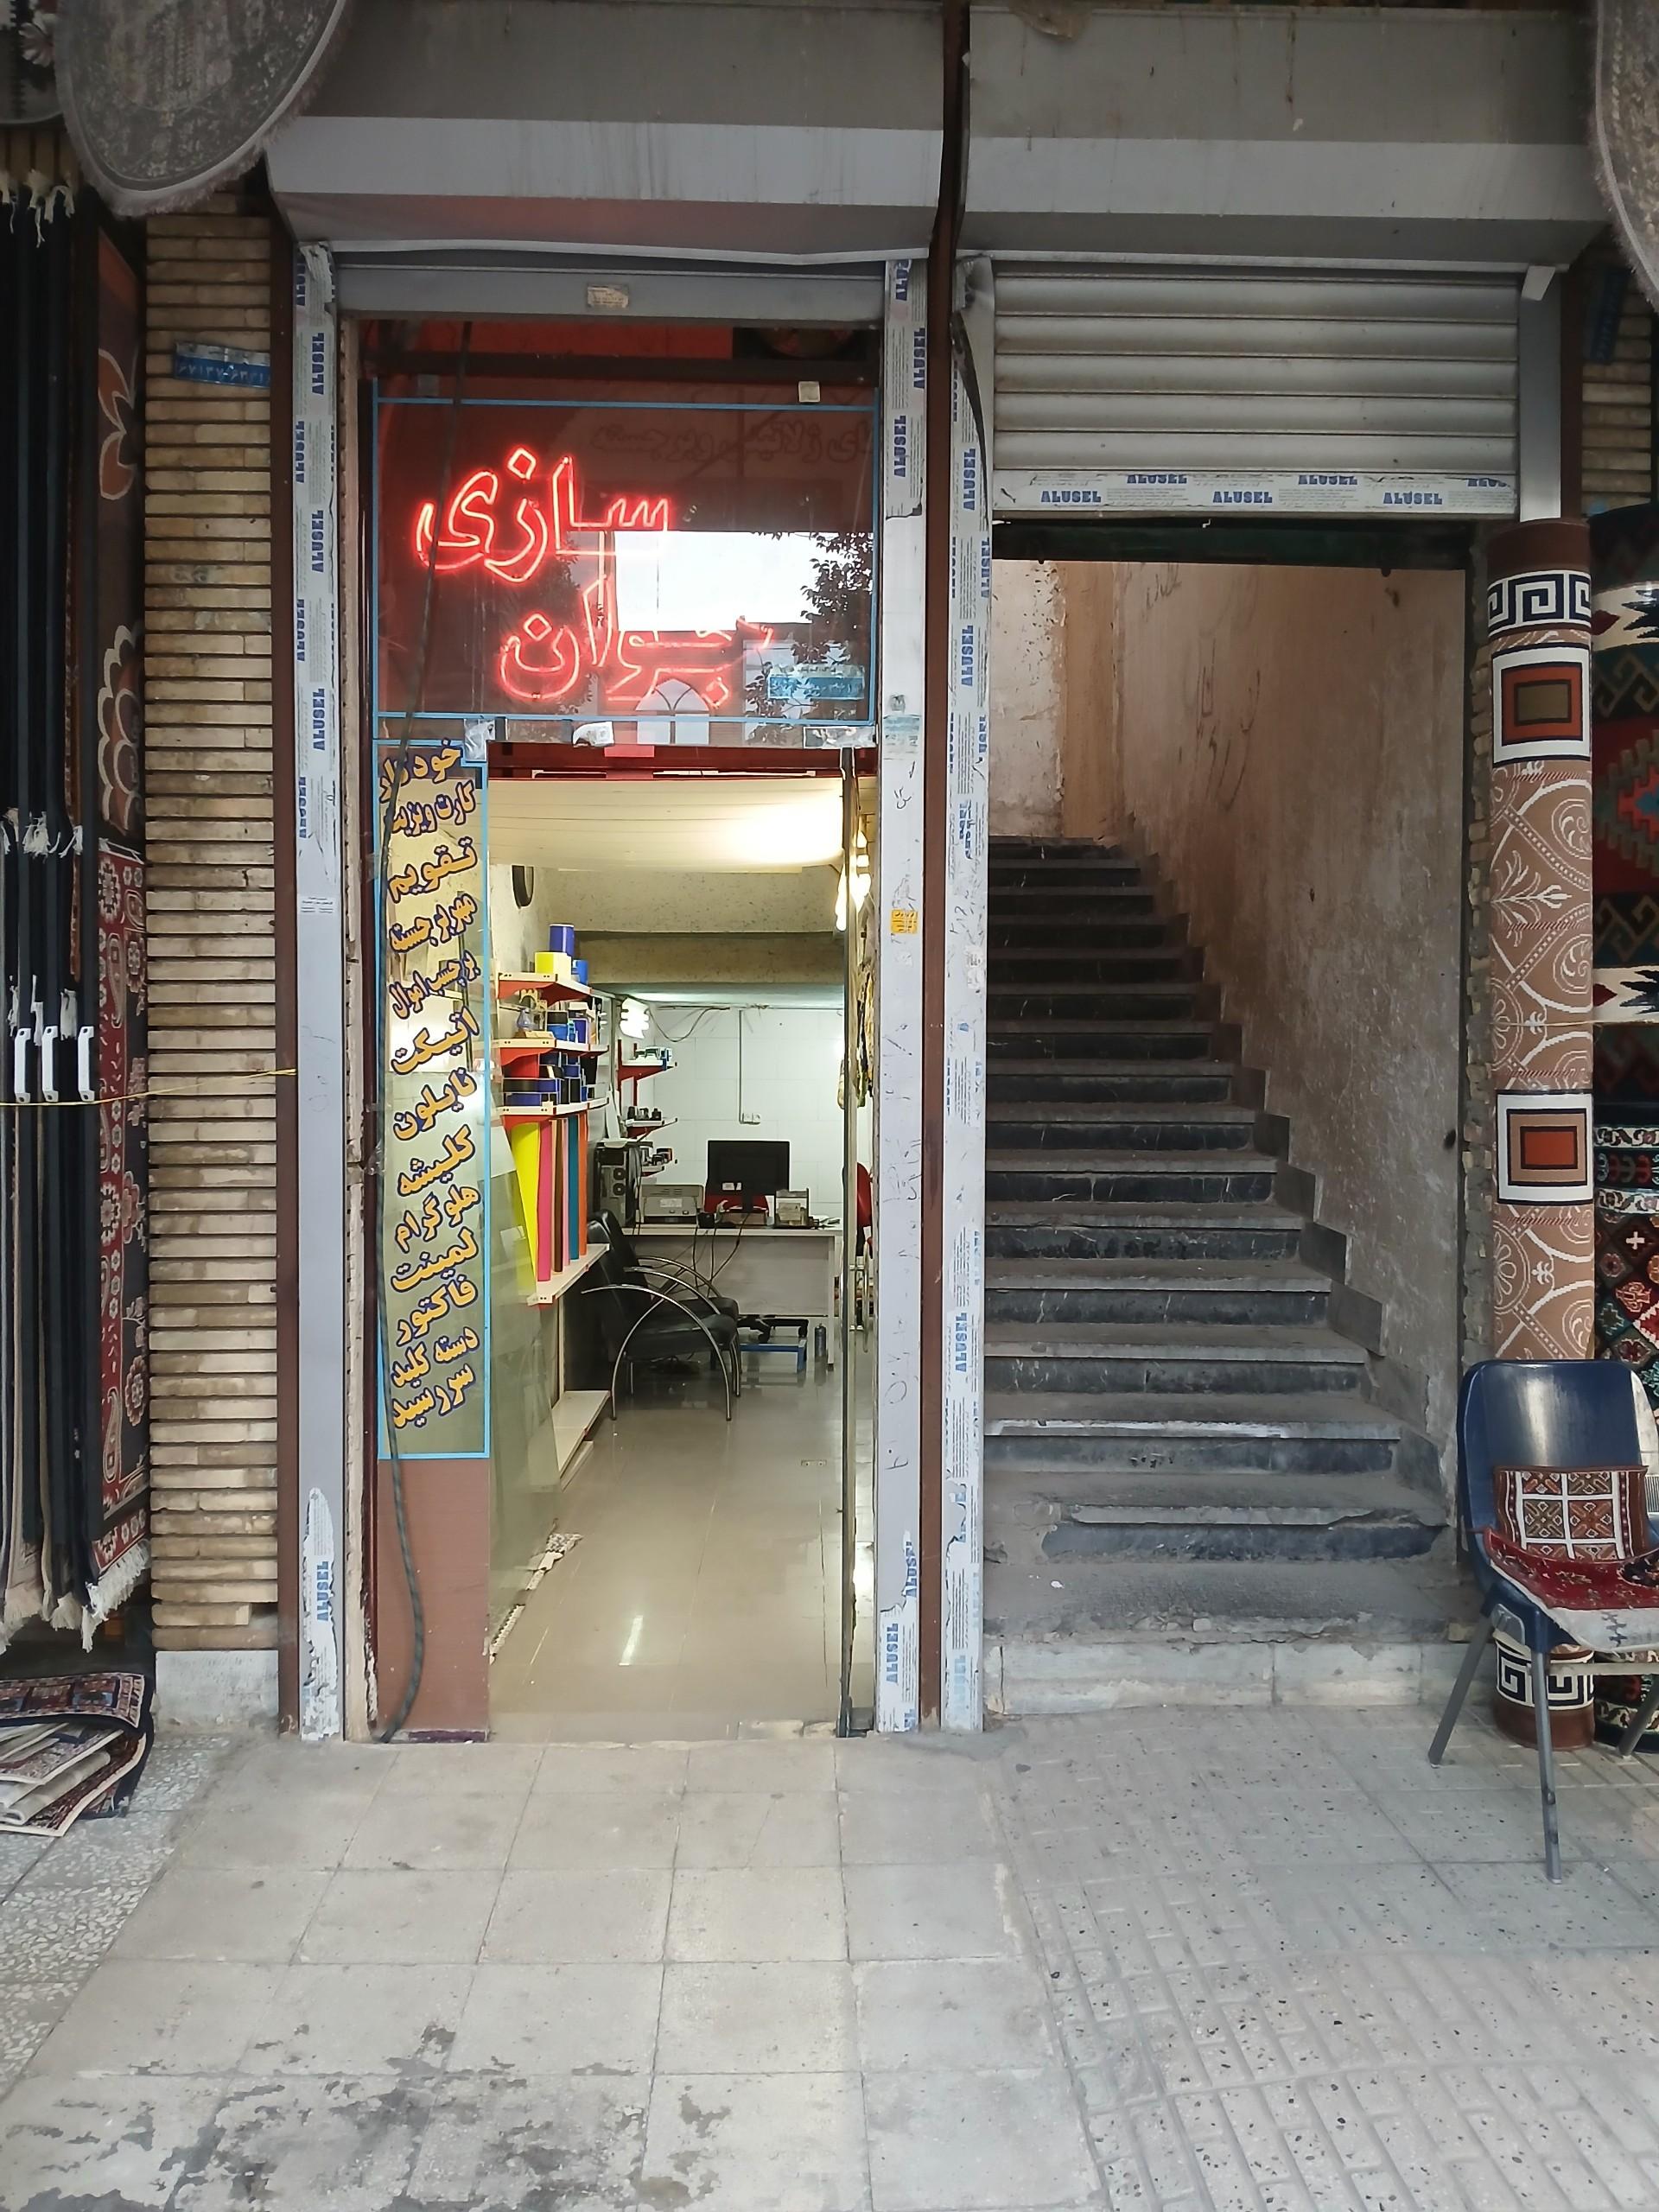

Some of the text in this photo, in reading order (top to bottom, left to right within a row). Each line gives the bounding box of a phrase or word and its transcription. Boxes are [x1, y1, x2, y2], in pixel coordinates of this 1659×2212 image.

[312, 333, 325, 395] ALUSEL
[913, 327, 926, 390] ALUSEL
[296, 421, 305, 483] ALUSEL
[893, 416, 906, 478] ALUSEL
[963, 448, 976, 510] ALUSEL
[1040, 490, 1102, 504] ALUSEL
[1212, 491, 1273, 504] ALUSEL
[1382, 492, 1443, 505] ALUSEL
[312, 510, 324, 573] ALUSEL
[961, 625, 974, 687] ALUSEL
[313, 689, 325, 751] ALUSEL
[391, 779, 476, 837] کارت ویزی
[388, 836, 478, 904] تقویم
[448, 893, 478, 937] مهر
[389, 969, 430, 1020] اموال
[391, 1006, 480, 1075] اتیکت
[393, 1067, 478, 1141] نایلون
[397, 1124, 476, 1197] کلیشه
[391, 1227, 479, 1293] لمینت
[396, 1274, 478, 1347] فاکتور
[391, 1326, 480, 1388] دسته کلید
[955, 1312, 967, 1372] ALUSEL
[316, 1560, 329, 1622] ALUSEL
[886, 1623, 899, 1684] ALUSEL
